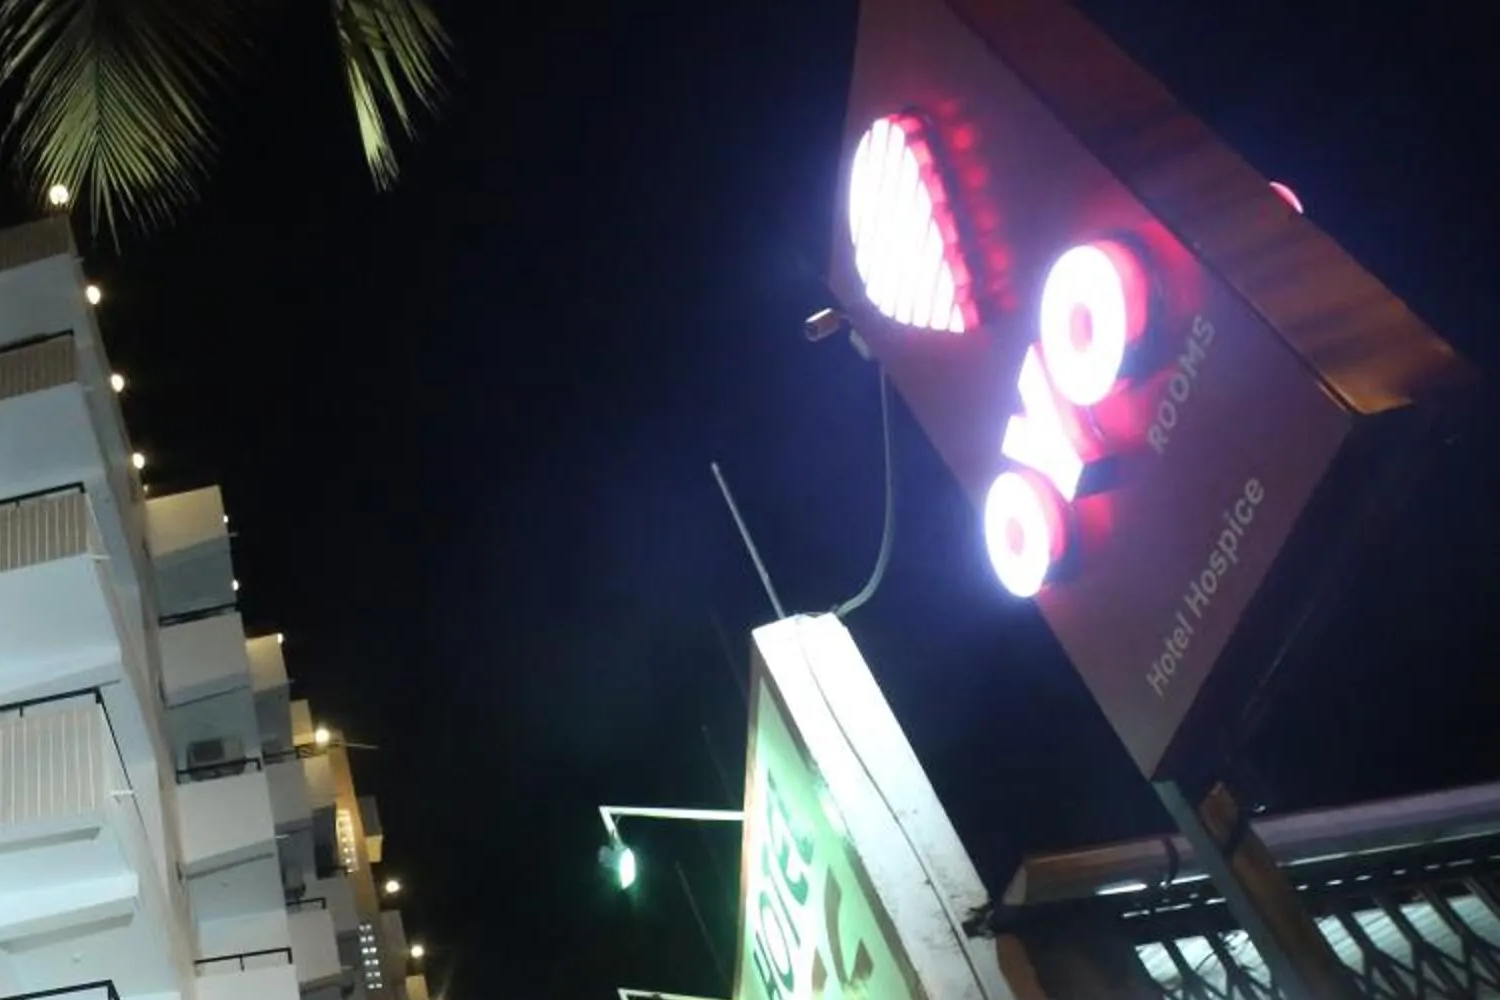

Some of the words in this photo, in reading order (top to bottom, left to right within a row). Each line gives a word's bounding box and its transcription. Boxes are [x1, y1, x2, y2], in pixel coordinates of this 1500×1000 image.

[984, 244, 1136, 598] OYO
[1148, 315, 1215, 455] ROOMS
[1147, 611, 1193, 696] Hotel
[1185, 478, 1264, 618] Hospice
